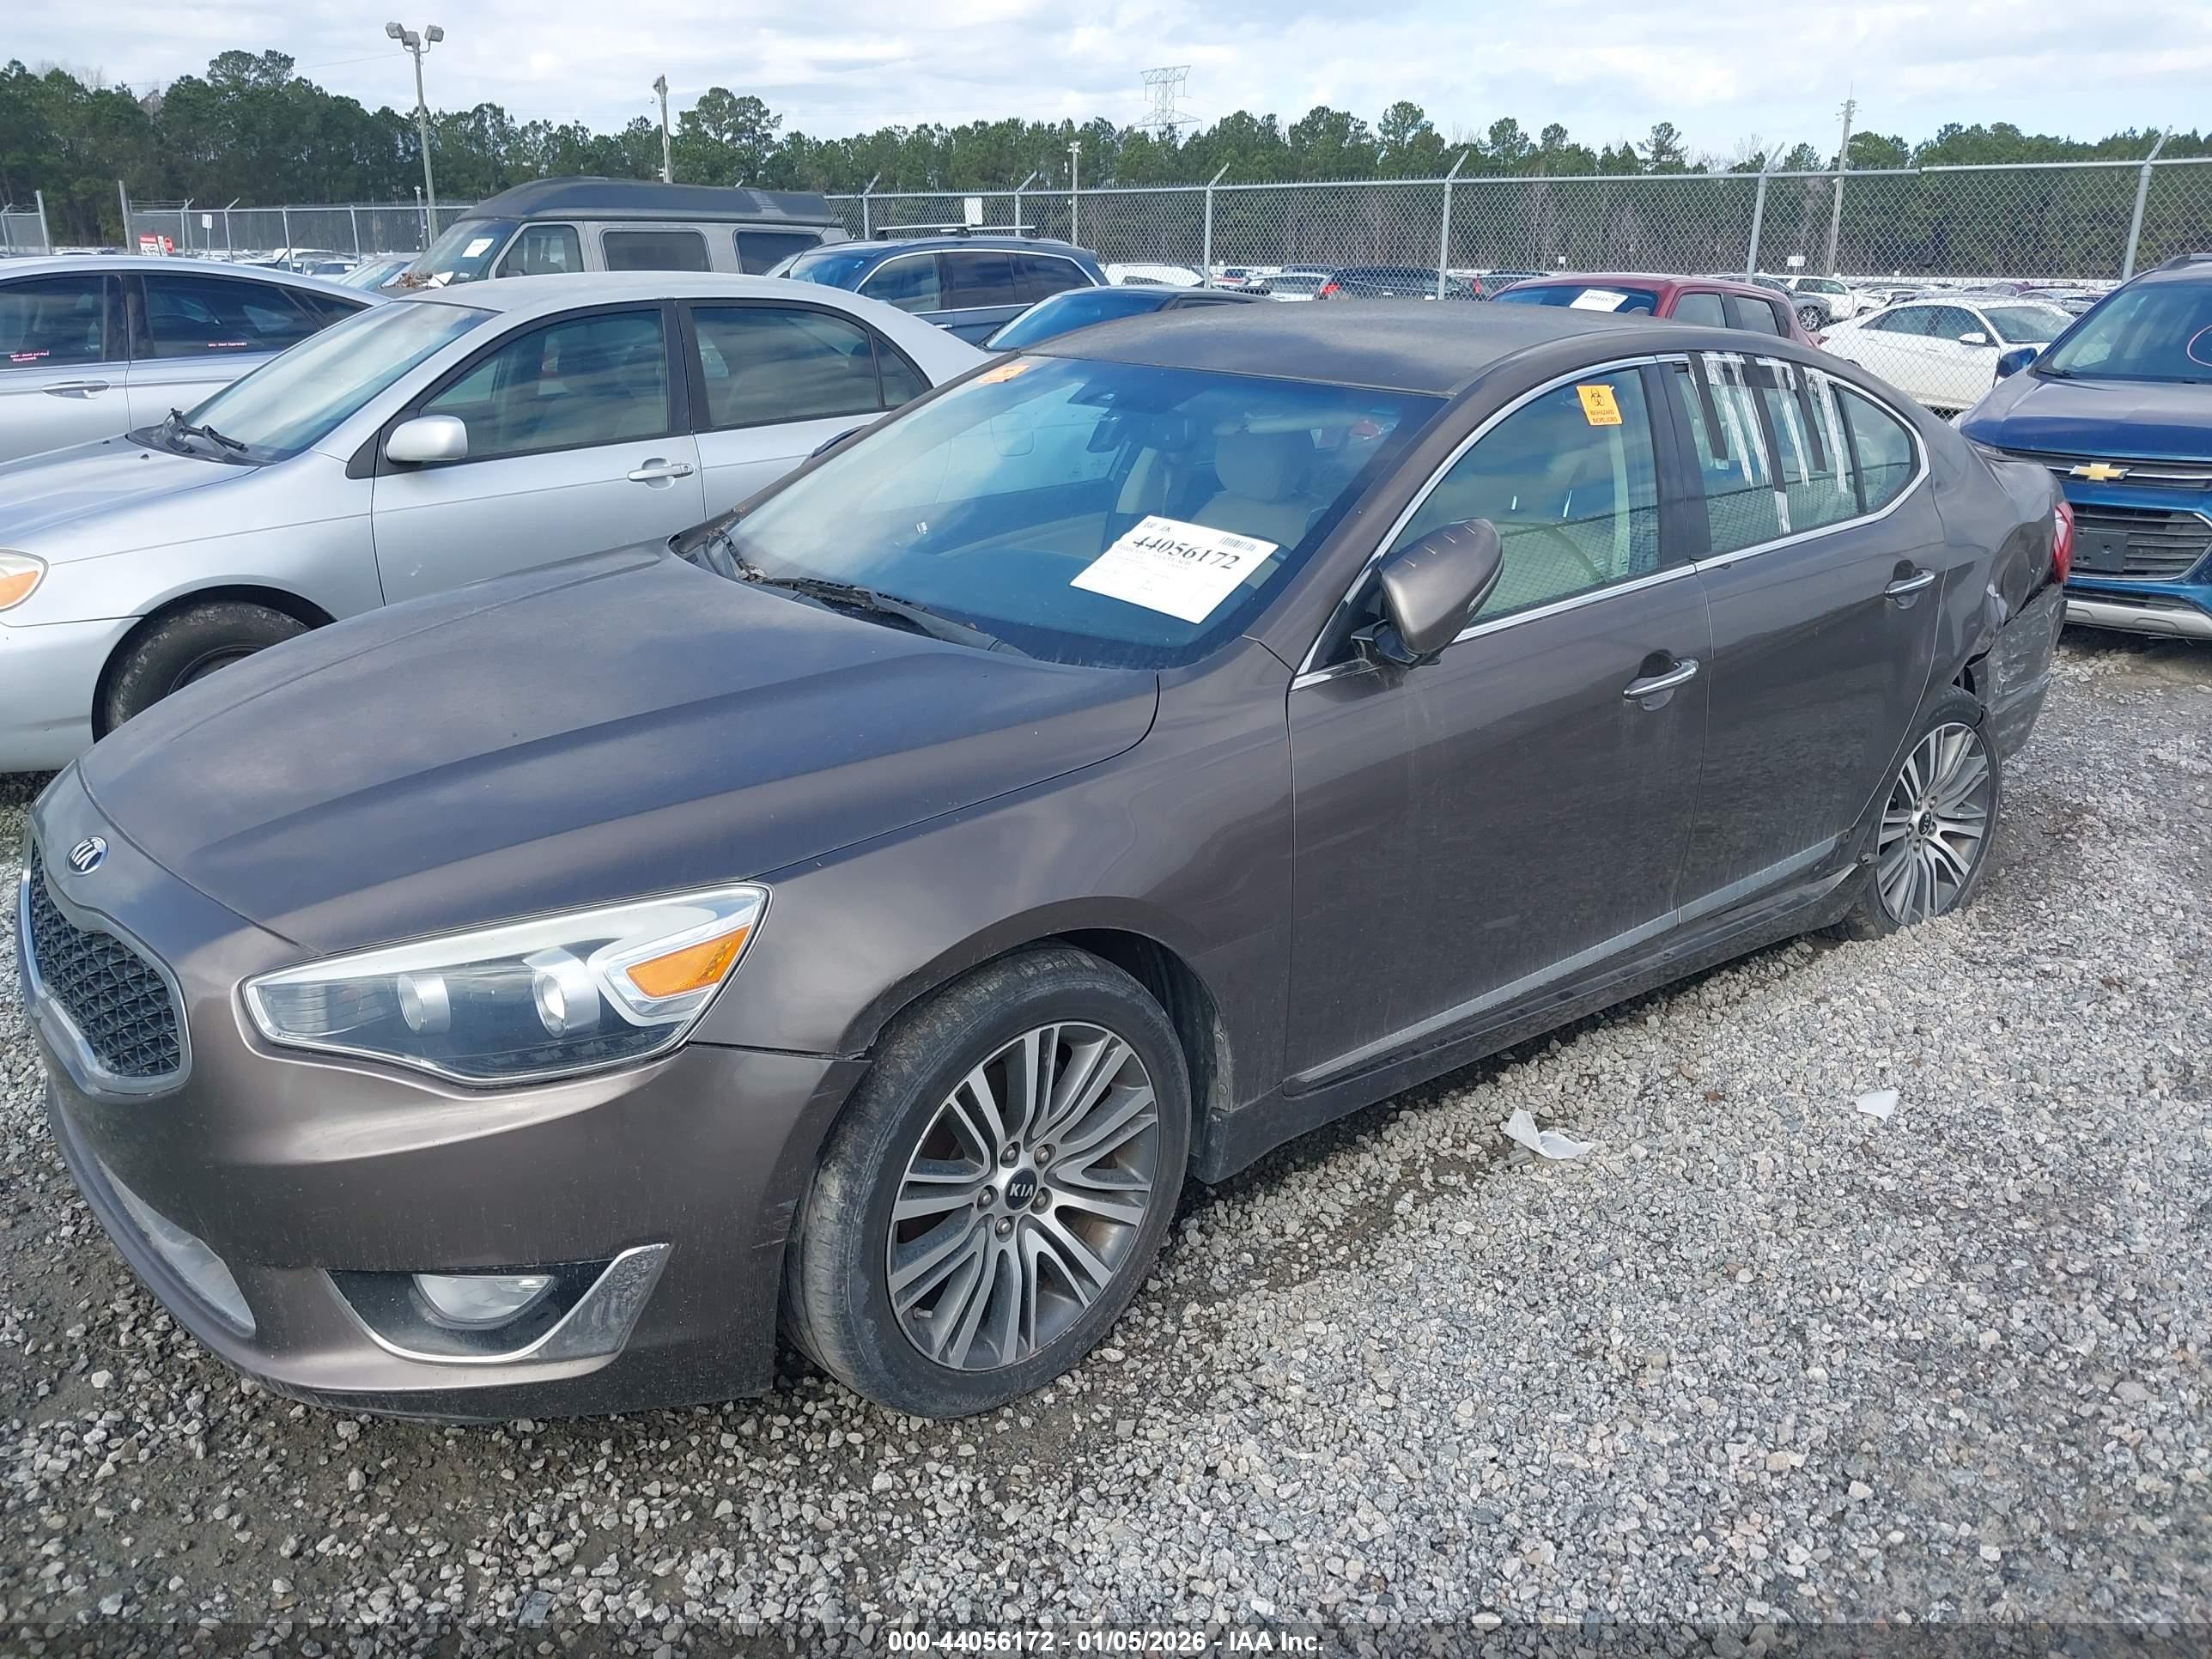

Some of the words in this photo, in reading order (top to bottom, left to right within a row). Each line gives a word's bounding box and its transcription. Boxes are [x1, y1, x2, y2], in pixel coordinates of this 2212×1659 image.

[1133, 536, 1241, 570] 44056172
[1922, 813, 1930, 834] KIA
[1009, 1182, 1034, 1197] KIA
